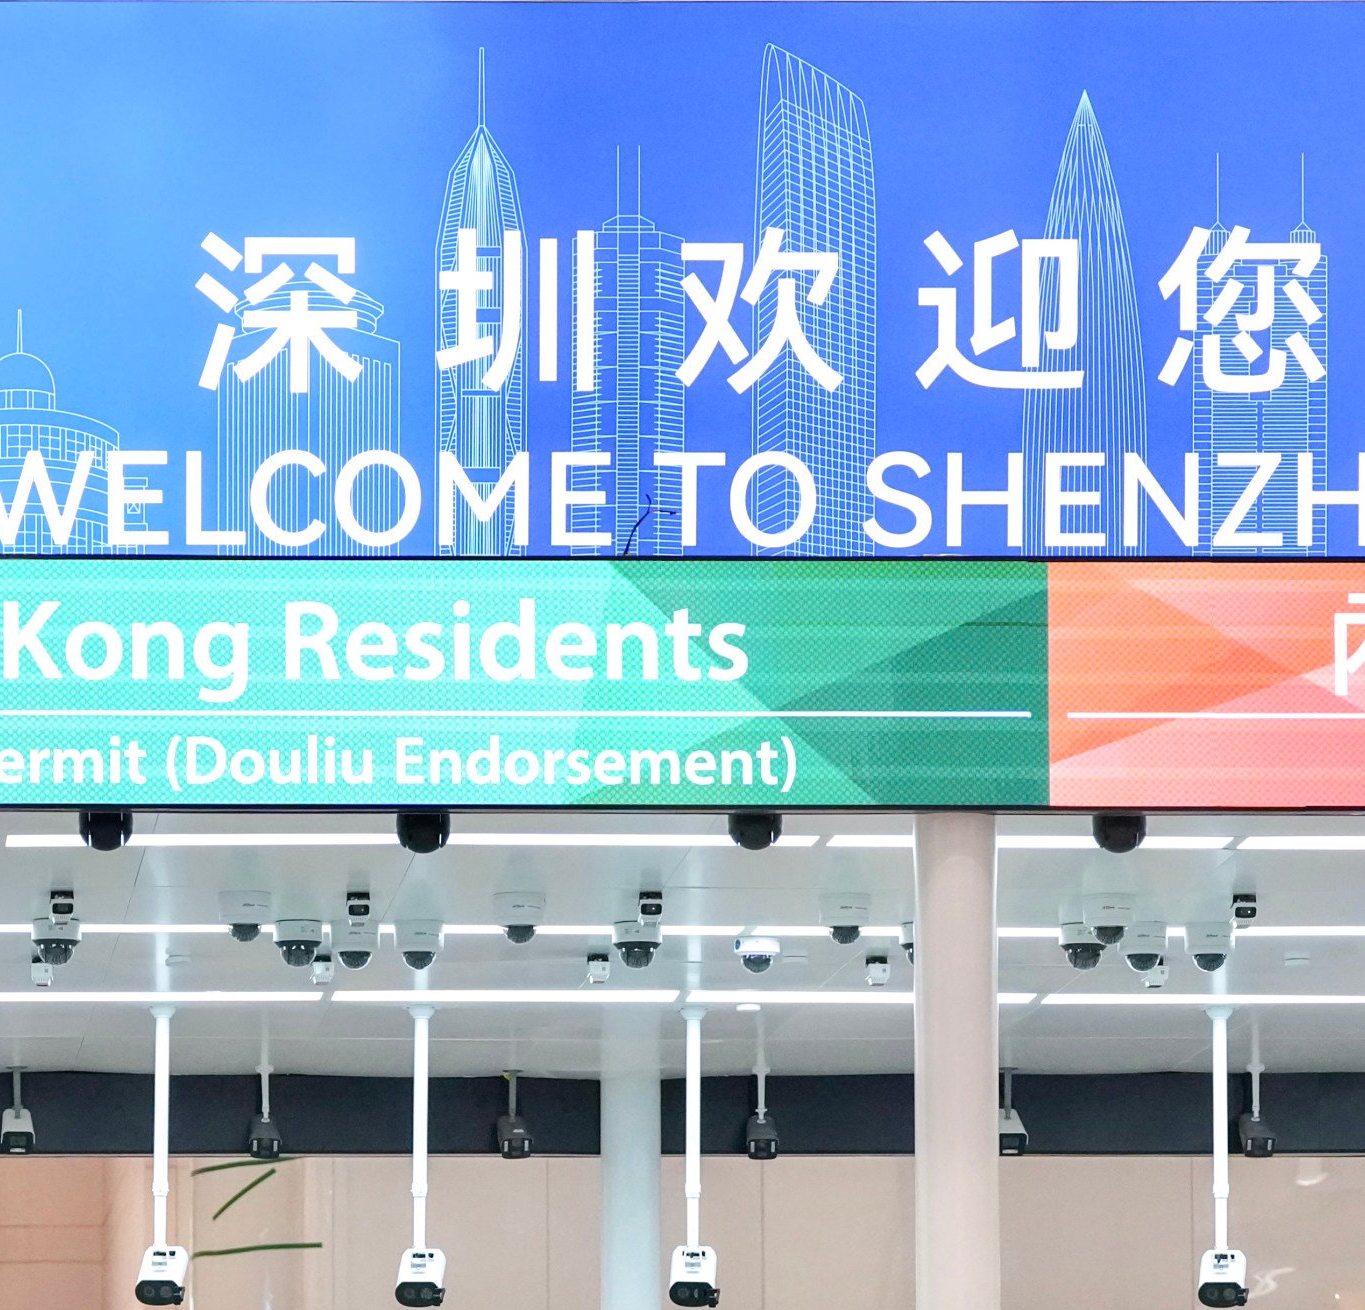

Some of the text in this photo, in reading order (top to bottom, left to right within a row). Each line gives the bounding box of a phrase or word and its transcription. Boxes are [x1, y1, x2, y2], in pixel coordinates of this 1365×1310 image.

[195, 225, 1326, 394] 深圳欢迎您
[652, 451, 818, 548] TO
[2, 600, 250, 703] Kong
[284, 597, 749, 684] Residents
[166, 734, 374, 792] (Douliu
[395, 734, 797, 793] Endorsement)
